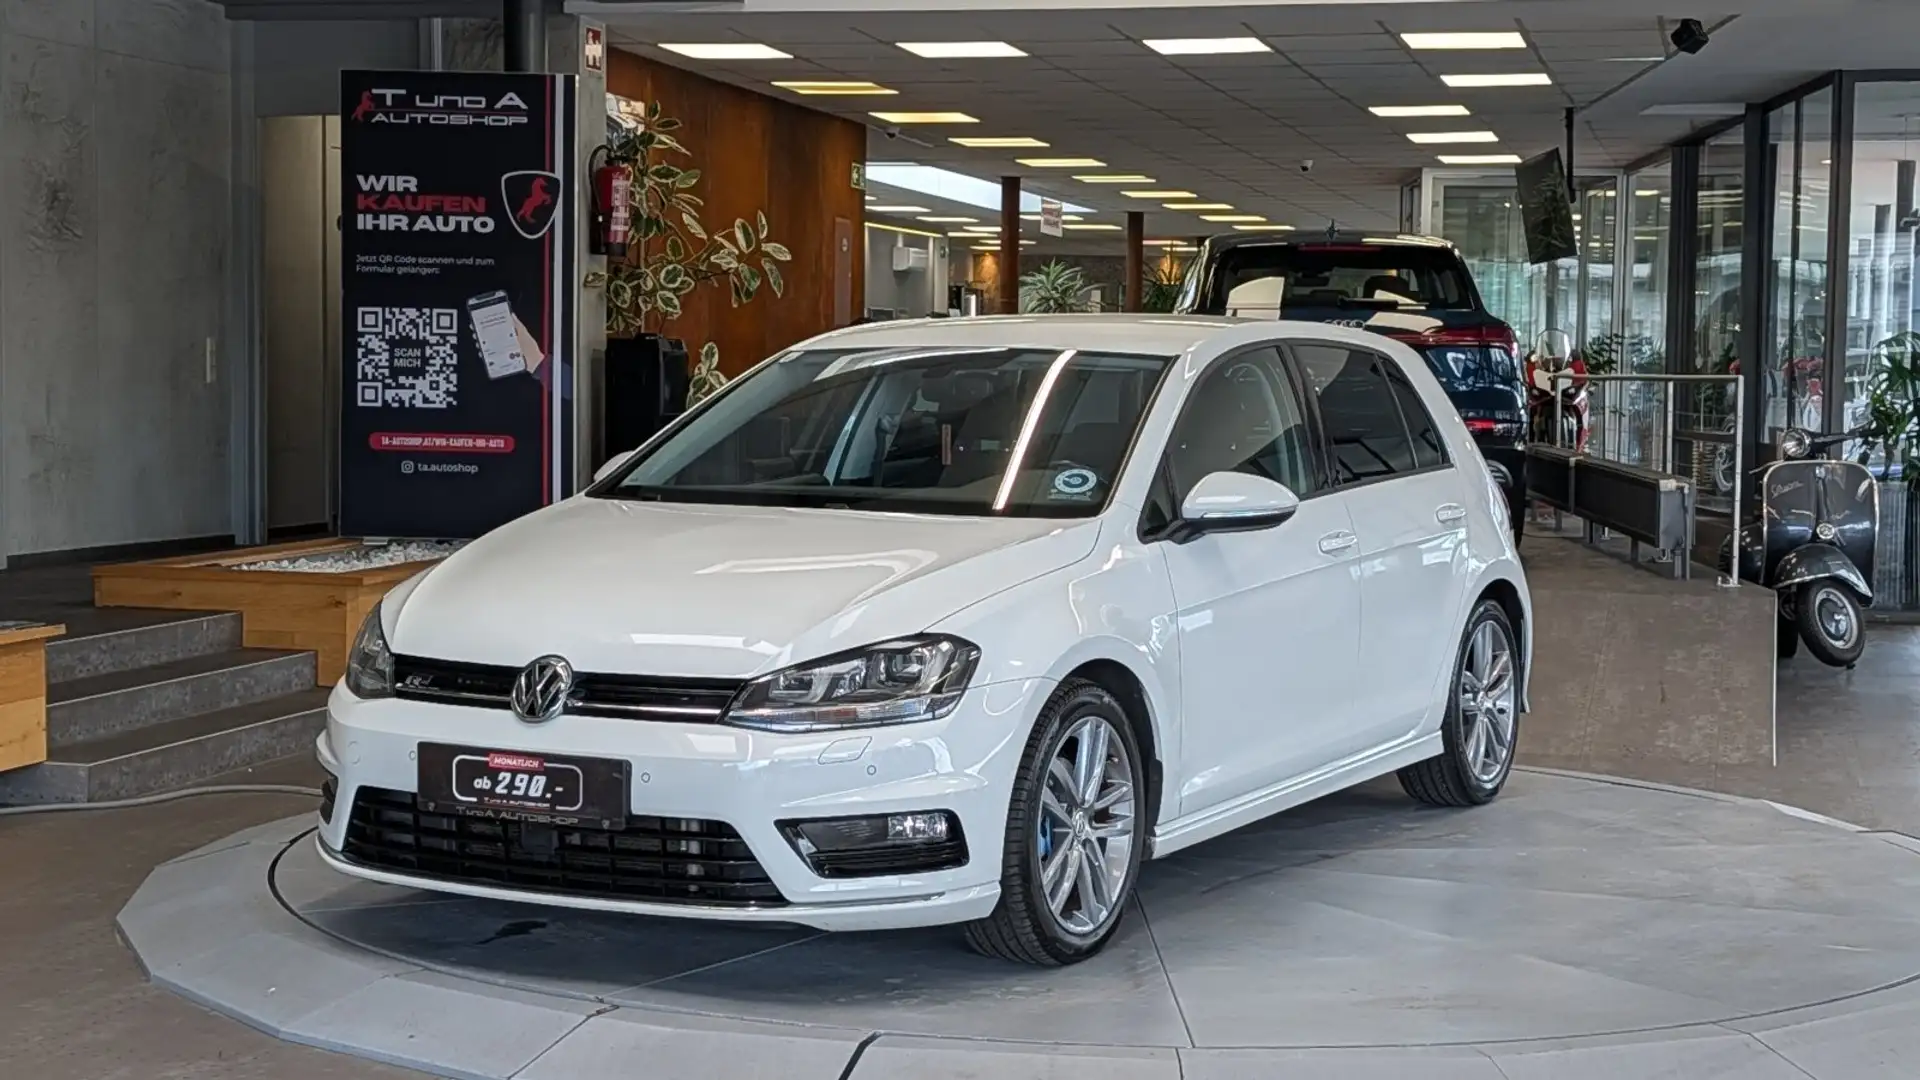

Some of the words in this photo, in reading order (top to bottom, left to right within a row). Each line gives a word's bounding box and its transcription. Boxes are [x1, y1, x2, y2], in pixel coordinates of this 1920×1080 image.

[371, 89, 406, 106] T
[494, 92, 528, 110] A
[371, 112, 528, 126] AUTOSHOP
[357, 175, 418, 192] WIR
[357, 194, 486, 213] KAUFEN
[357, 214, 408, 232] IHR
[413, 215, 495, 233] AUTO
[356, 254, 377, 263] Jetzt
[379, 254, 393, 264] QR
[394, 255, 417, 264] Code
[418, 256, 454, 264] scannen
[456, 257, 473, 265] und
[475, 258, 495, 266] zum
[356, 264, 396, 273] Formular
[394, 348, 421, 357] SCAN
[394, 358, 421, 368] MICH
[417, 462, 479, 474] ta.autoshop
[494, 757, 539, 768] MONATLICH
[473, 776, 492, 790] ab
[500, 811, 578, 825] AUTOSHOP
